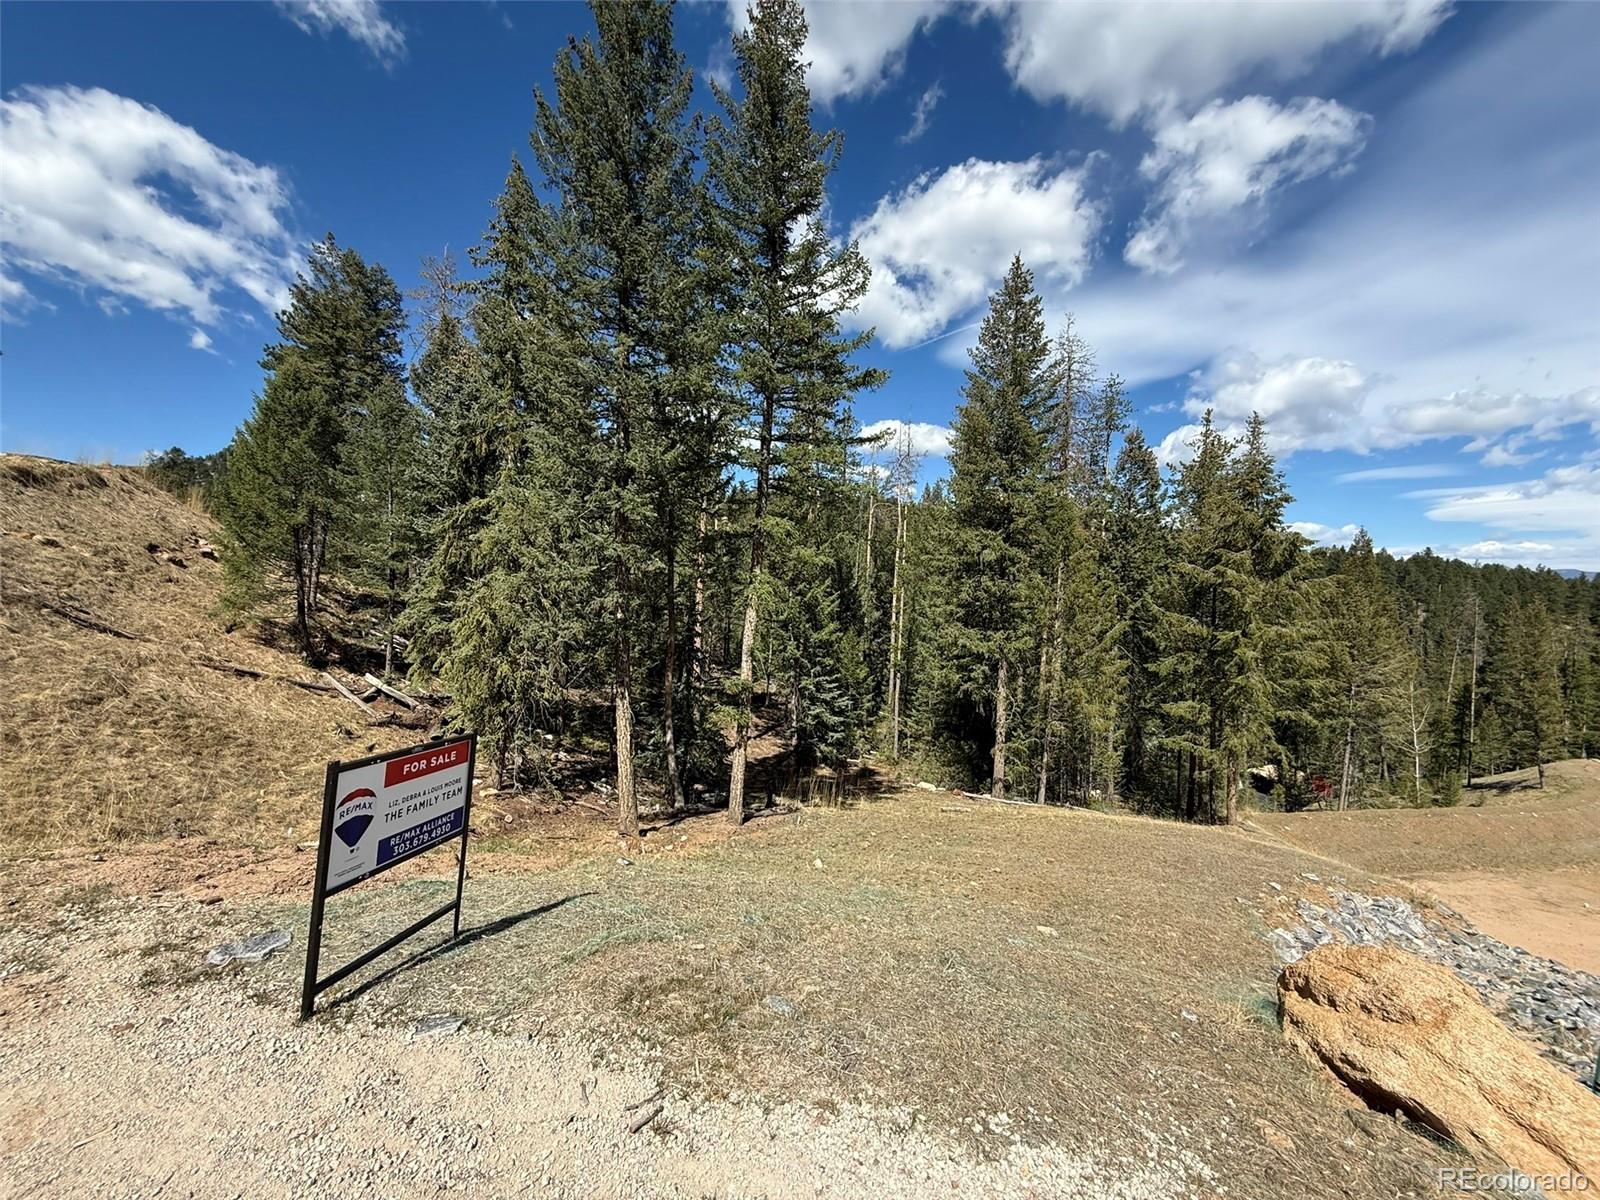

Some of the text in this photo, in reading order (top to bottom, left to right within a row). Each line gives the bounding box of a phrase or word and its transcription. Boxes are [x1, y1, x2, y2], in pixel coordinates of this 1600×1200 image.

[403, 751, 457, 775] FOR SALE
[384, 786, 463, 823] THE FAMILY TEAM
[401, 792, 422, 804] DEBRA
[427, 784, 444, 795] LOUIS
[444, 778, 462, 789] MOORE
[339, 801, 374, 820] RE/MAX
[390, 812, 455, 846] RE/MAX ALLIANCE
[393, 823, 451, 856] 303.679.4930
